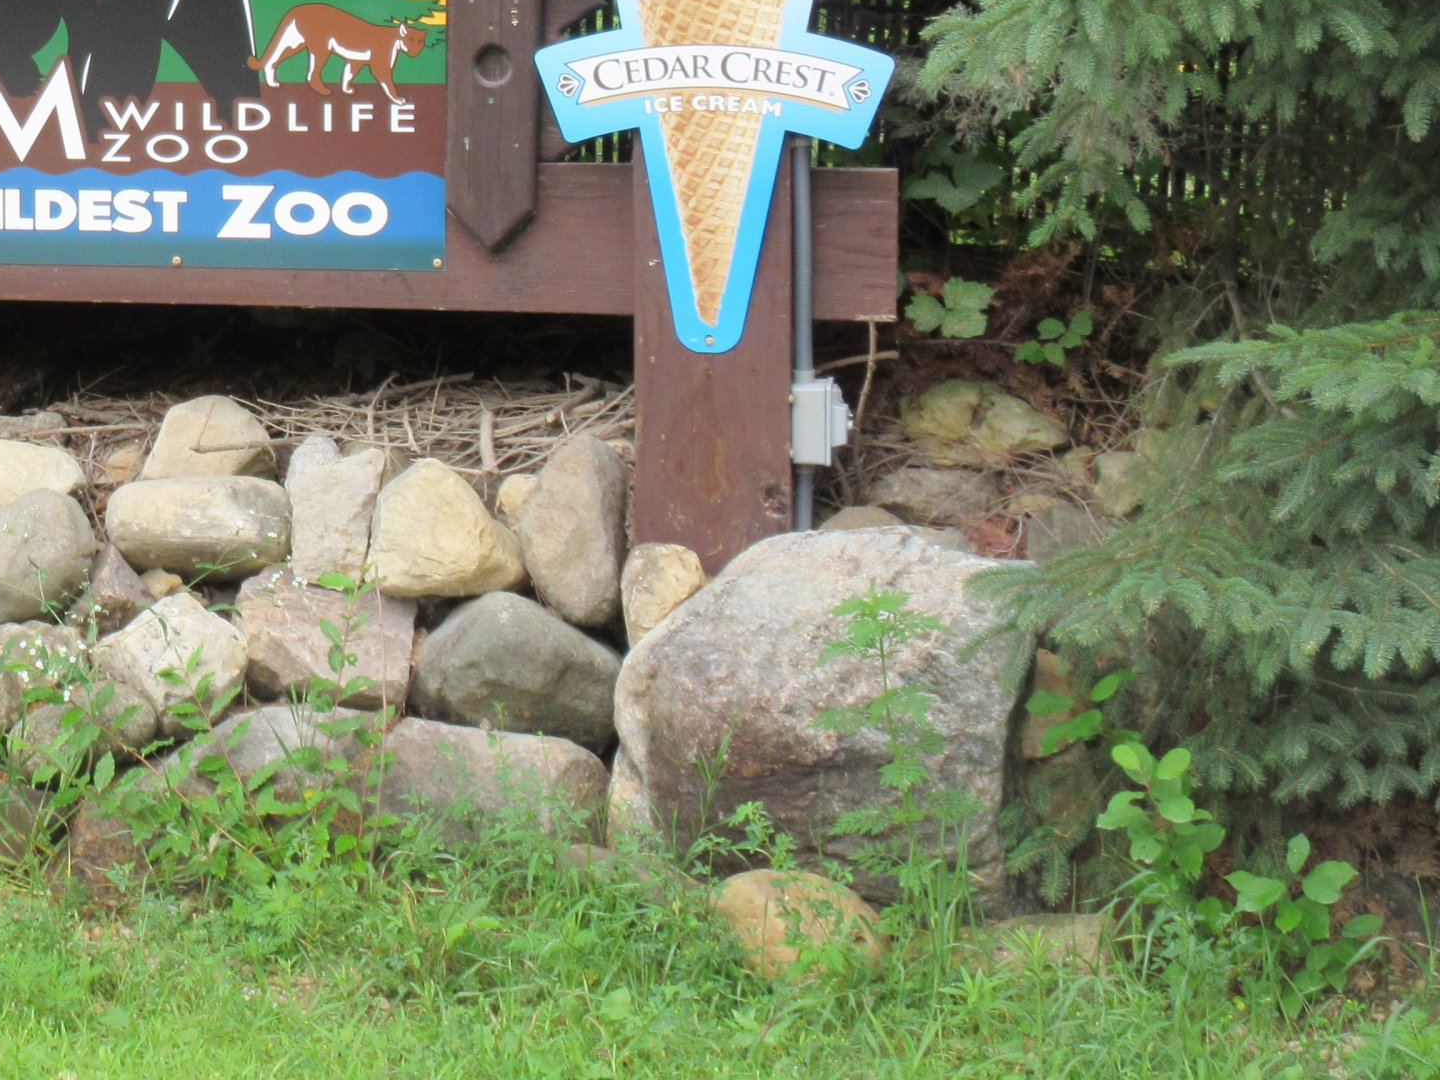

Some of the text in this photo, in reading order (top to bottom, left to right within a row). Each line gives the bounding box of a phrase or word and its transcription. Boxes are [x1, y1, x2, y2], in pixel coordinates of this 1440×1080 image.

[593, 54, 713, 91] CEDAR
[104, 101, 416, 133] WILDLIFE
[644, 95, 783, 118] ICE CREAM
[101, 133, 250, 164] ZOO
[216, 184, 389, 239] ZOO
